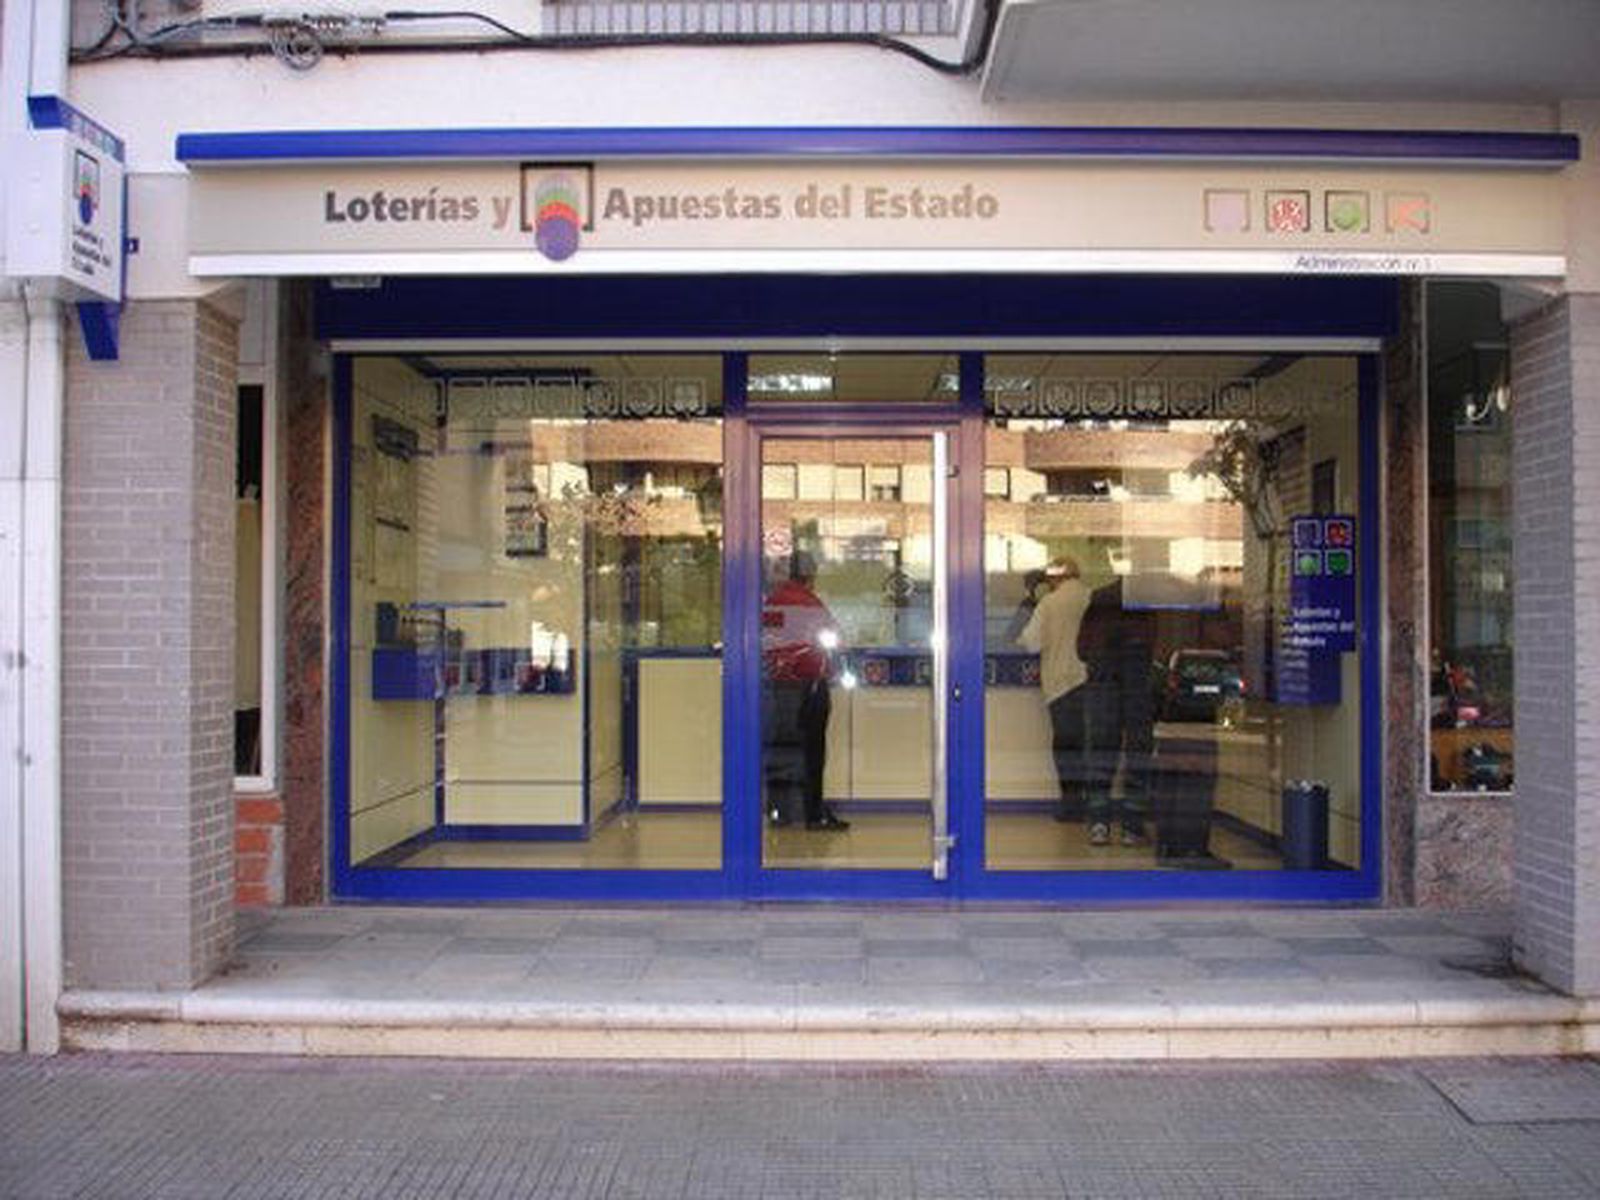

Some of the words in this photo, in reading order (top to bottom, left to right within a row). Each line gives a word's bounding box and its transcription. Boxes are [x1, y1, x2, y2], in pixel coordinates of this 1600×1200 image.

[325, 187, 480, 222] Loterías
[492, 195, 512, 229] y
[602, 187, 783, 227] Apuestas
[794, 184, 851, 220] del
[864, 184, 1000, 220] Estado
[1295, 255, 1401, 270] Adminisción
